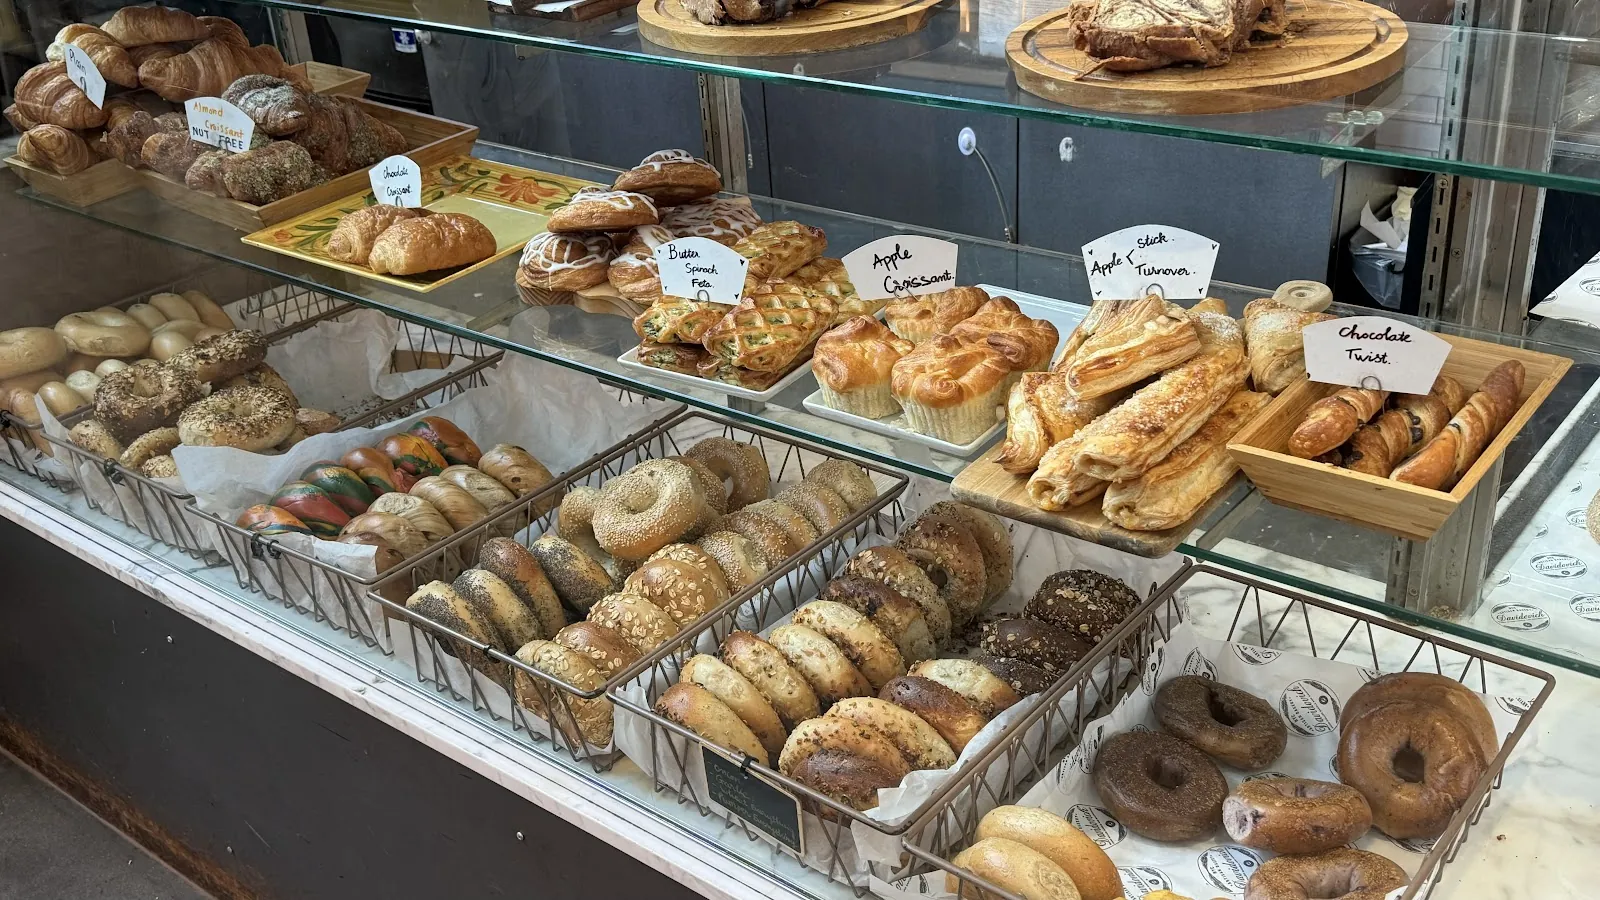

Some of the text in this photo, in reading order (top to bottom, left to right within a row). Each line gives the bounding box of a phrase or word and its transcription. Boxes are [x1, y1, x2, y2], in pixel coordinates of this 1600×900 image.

[69, 48, 87, 76] Plain
[193, 101, 224, 117] Almond
[192, 126, 244, 150] NUT FREE
[204, 119, 245, 138] Croissant
[668, 244, 701, 260] Butter
[872, 243, 913, 272] Apple
[685, 262, 719, 276] Spinach
[1090, 252, 1123, 277] Apple
[1338, 324, 1412, 343] Chocolate
[1287, 685, 1331, 731] Davidovich
